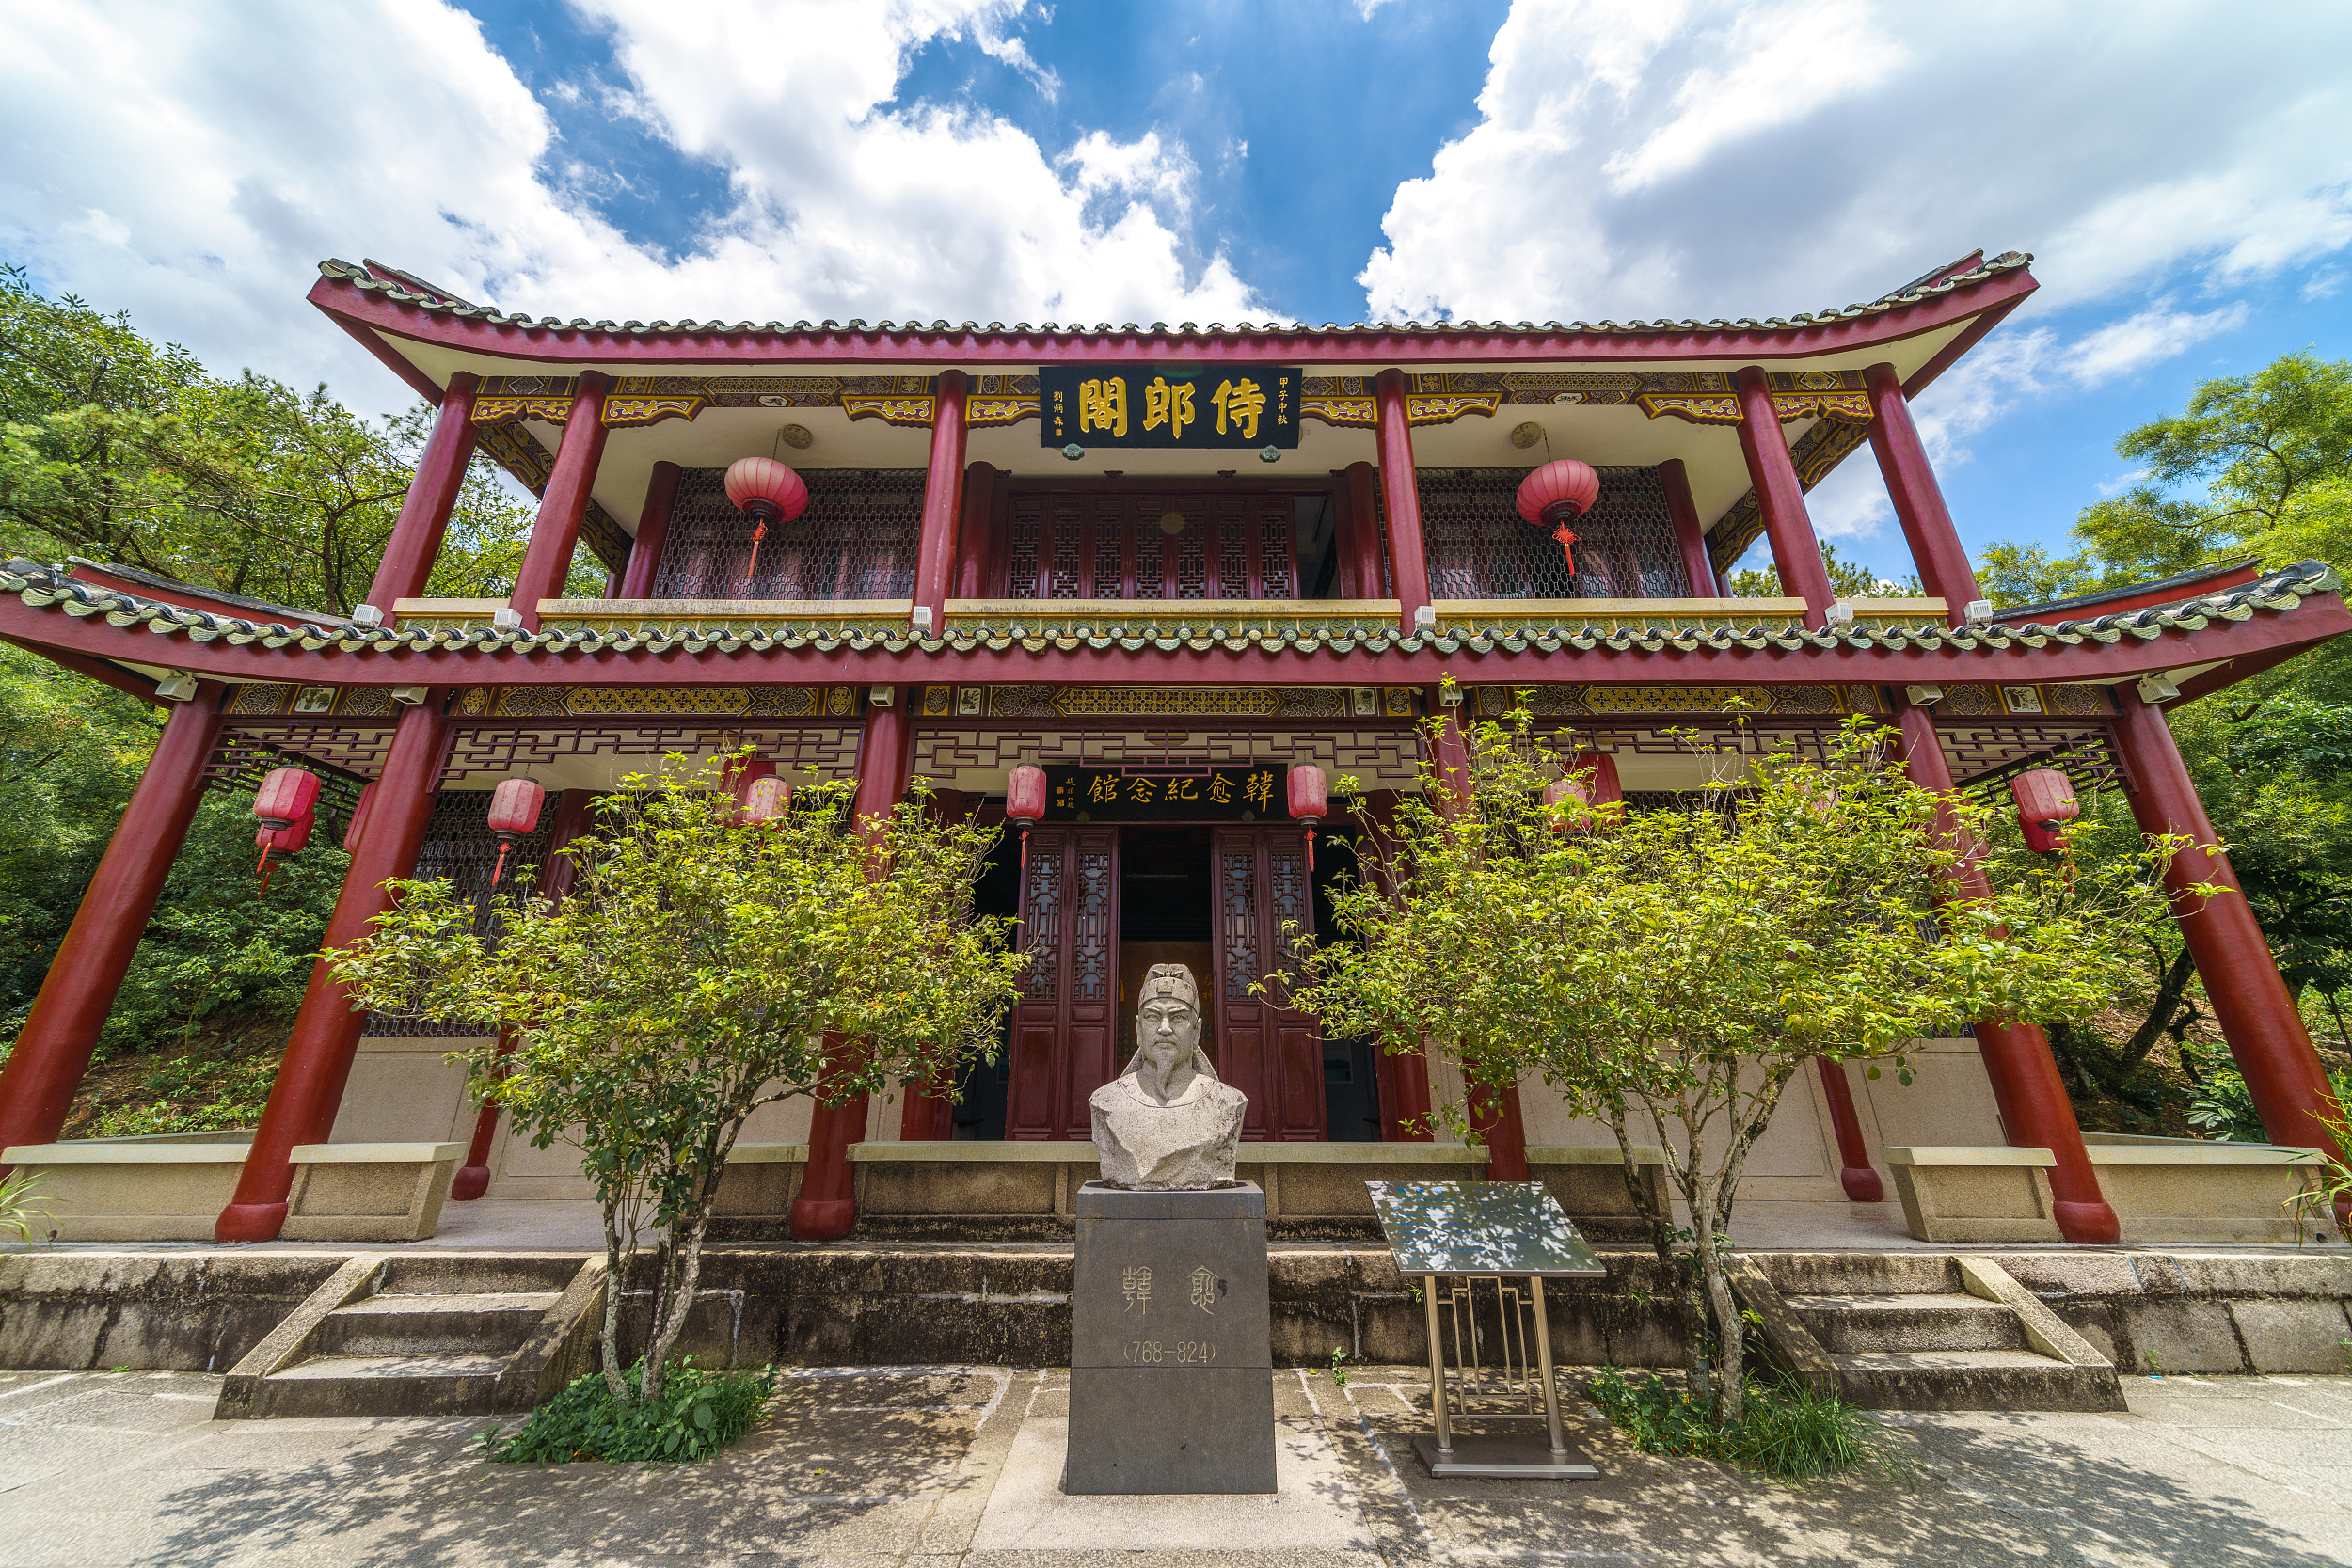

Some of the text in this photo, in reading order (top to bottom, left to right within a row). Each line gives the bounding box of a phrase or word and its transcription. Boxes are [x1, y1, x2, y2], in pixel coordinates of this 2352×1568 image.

[1079, 377, 1266, 439] 侍郎閣
[1278, 377, 1288, 424] 甲子中秋
[1087, 771, 1274, 812] 韓愈紀念館
[1123, 1340, 1216, 1363] (768-824)
